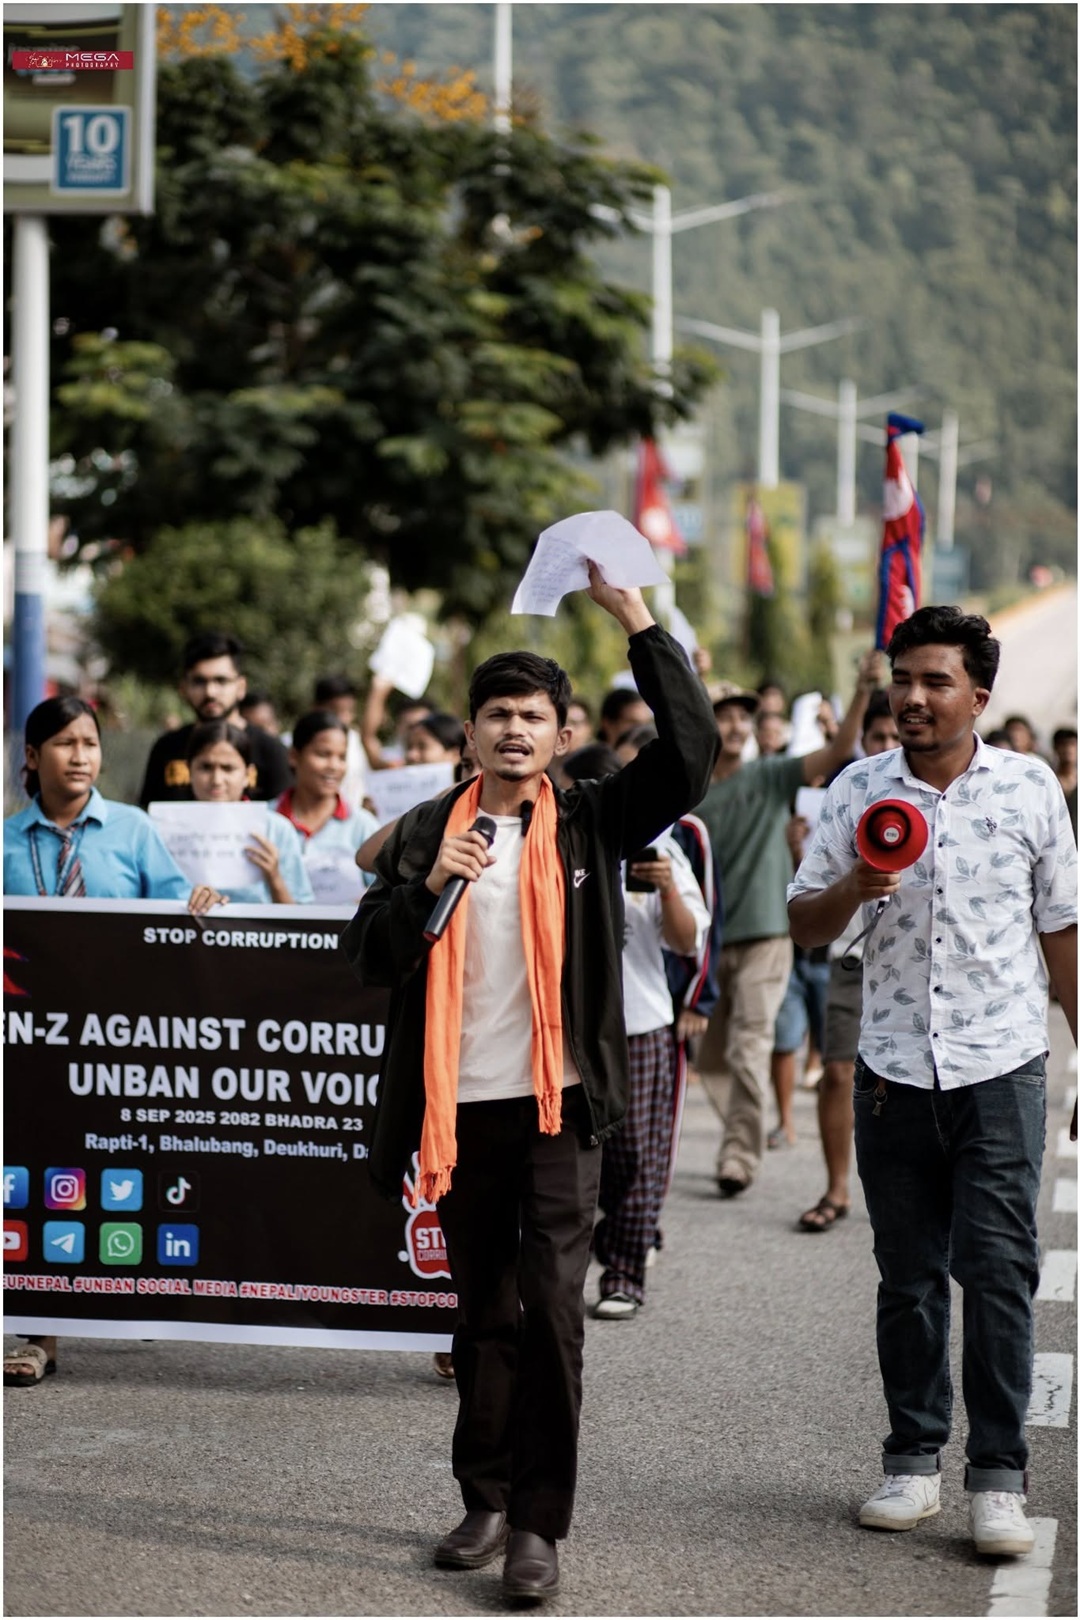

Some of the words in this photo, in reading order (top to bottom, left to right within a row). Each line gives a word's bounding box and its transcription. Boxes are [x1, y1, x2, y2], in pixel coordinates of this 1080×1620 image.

[63, 114, 119, 154] 10
[143, 927, 197, 944] STOP
[201, 930, 339, 950] CORRUPTION
[3, 1011, 69, 1045] N-Z
[80, 1013, 246, 1051] AGAINST
[257, 1019, 386, 1057] CORRU
[68, 1062, 200, 1099] UNBAN
[211, 1067, 292, 1103] OUR
[121, 1108, 131, 1122] 8
[136, 1109, 171, 1123] SEP
[174, 1110, 216, 1125] 2025
[219, 1112, 261, 1127] 2082
[264, 1114, 339, 1130] BHADRA
[342, 1117, 364, 1131] 23
[85, 1133, 155, 1153] Rapti-1,
[159, 1136, 259, 1158] Bhalubang,
[263, 1139, 348, 1162] Deukhuri,
[73, 1277, 134, 1294] #UNBAN
[137, 1278, 192, 1295] SOCIAL
[193, 1280, 238, 1297] MEDIA
[239, 1282, 388, 1304] #NEPALIYOUNGSTER
[390, 1291, 458, 1308] #STOPCO
